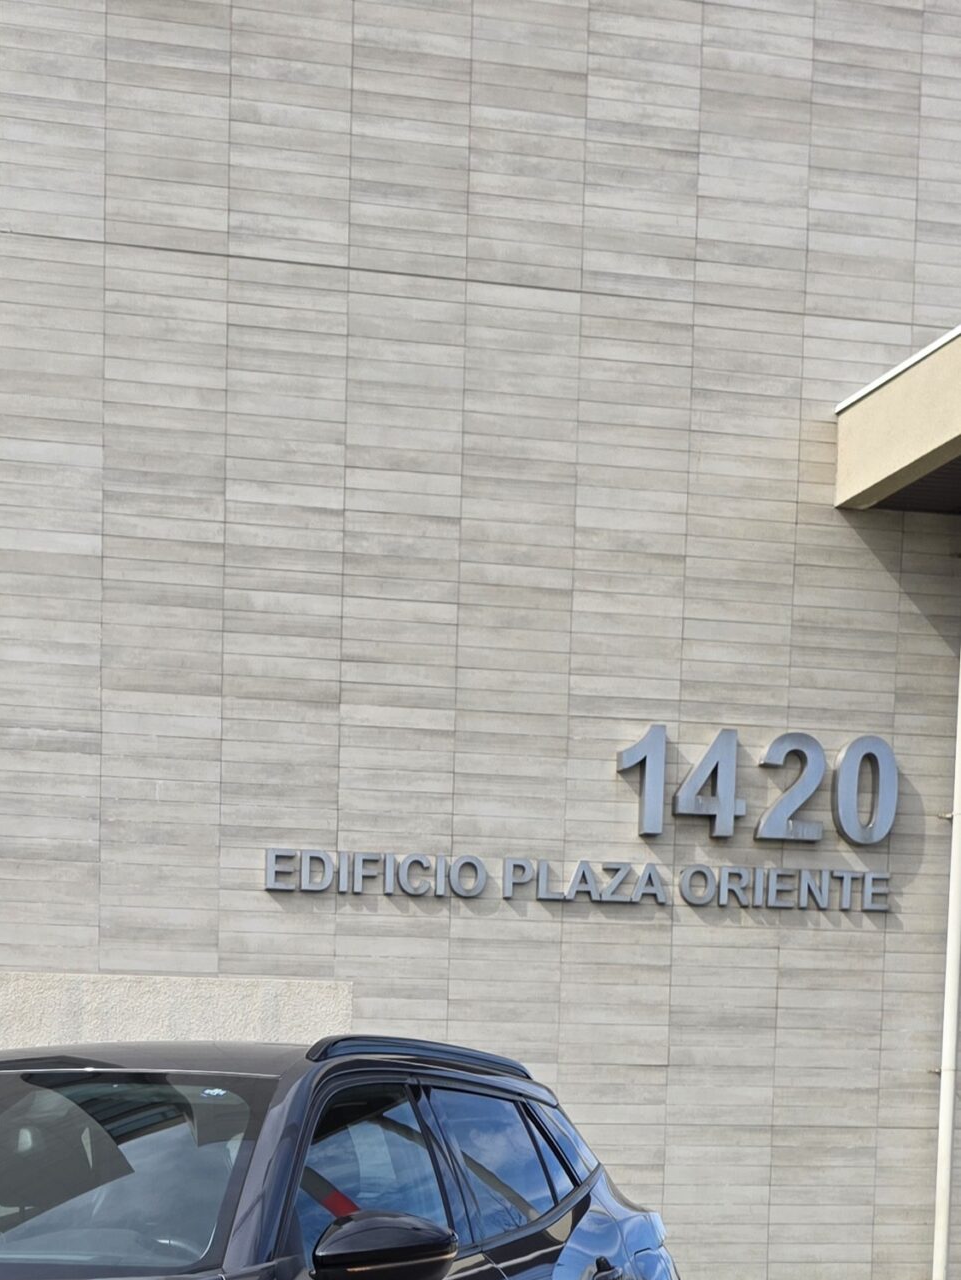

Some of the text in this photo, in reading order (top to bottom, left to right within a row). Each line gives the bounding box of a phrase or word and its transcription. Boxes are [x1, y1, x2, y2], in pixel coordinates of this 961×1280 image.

[616, 724, 899, 845] 1420
[265, 848, 890, 911] EDIFICIO PLAZA ORIENTE
